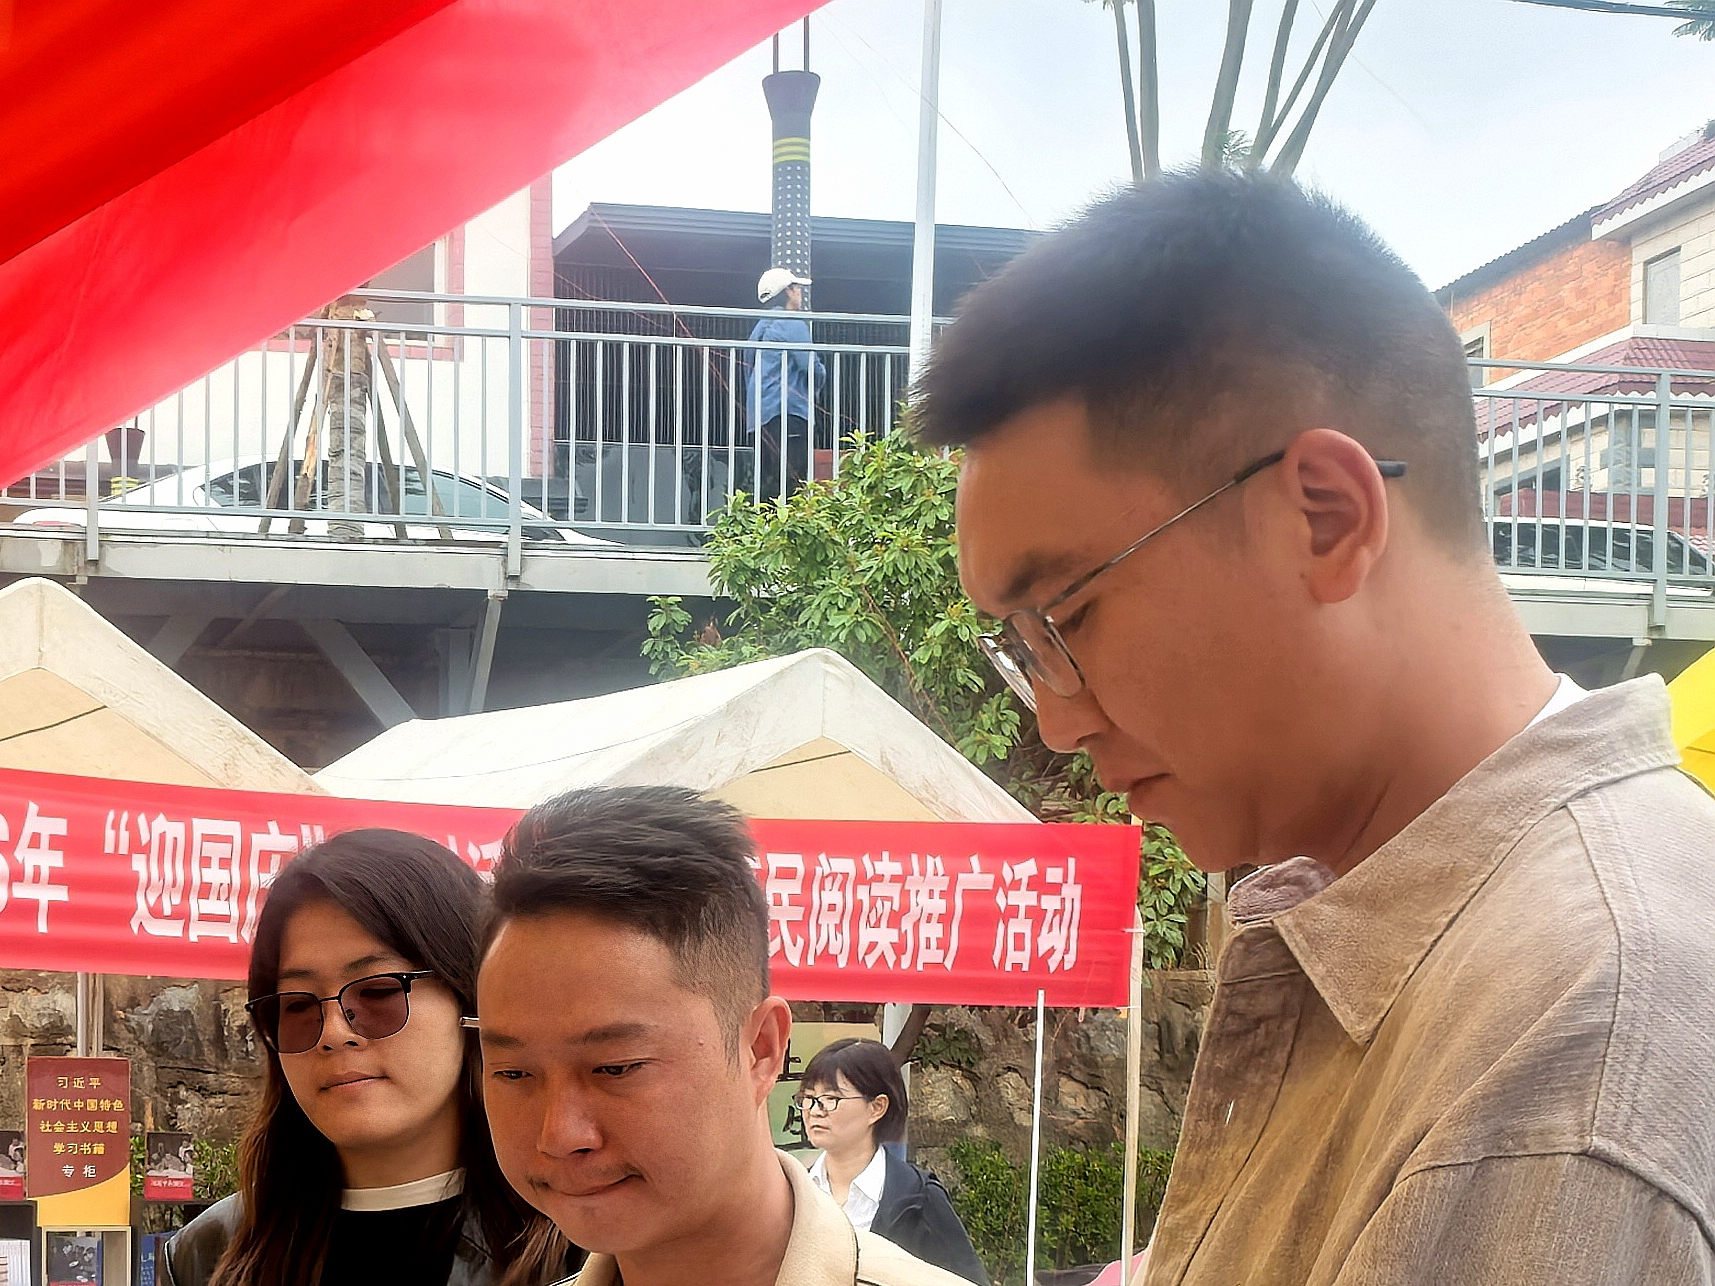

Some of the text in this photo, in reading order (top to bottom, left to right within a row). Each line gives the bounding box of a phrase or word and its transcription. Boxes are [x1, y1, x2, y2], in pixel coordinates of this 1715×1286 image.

[749, 852, 1082, 973] 民阅读推广活动
[57, 1077, 101, 1089] 习近平
[32, 1099, 125, 1111] 新时代中国特色
[39, 1121, 118, 1134] 社会主义思想
[53, 1143, 105, 1155] 学习书籍
[62, 1164, 97, 1178] 专柜
